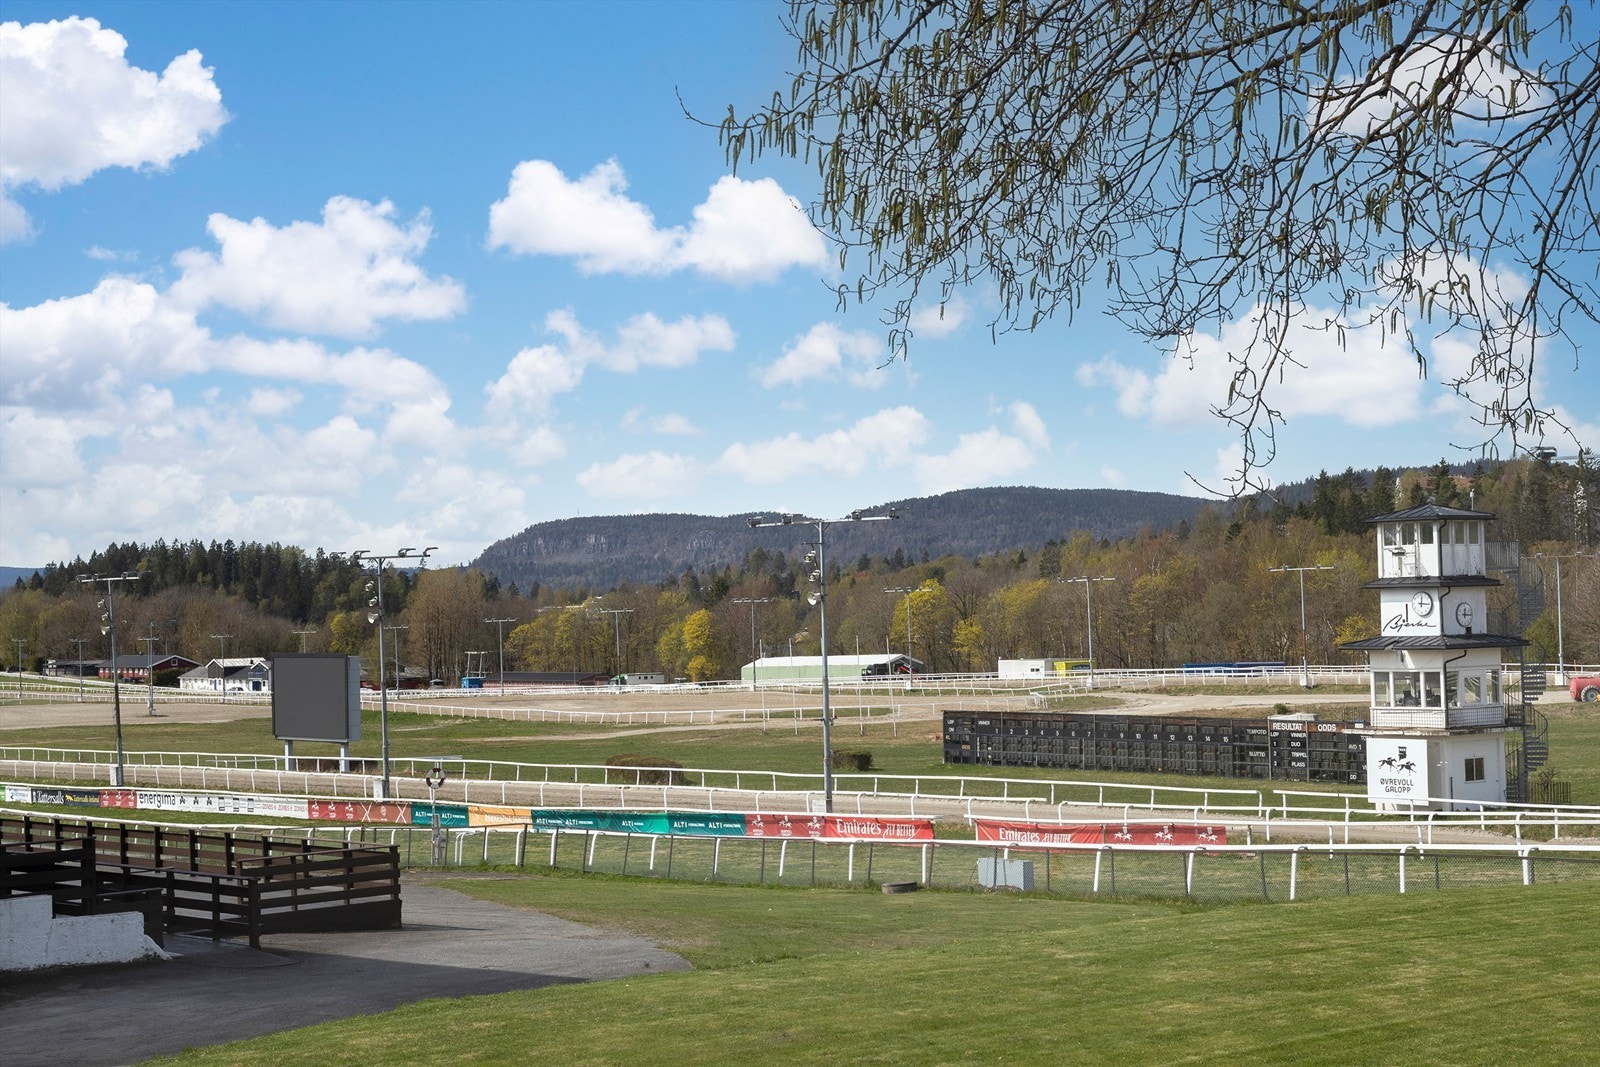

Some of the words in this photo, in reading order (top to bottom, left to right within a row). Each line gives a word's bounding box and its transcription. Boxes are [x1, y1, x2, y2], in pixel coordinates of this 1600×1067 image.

[1380, 778, 1414, 787] ØVREVOLL
[139, 793, 176, 808] energima
[836, 819, 881, 834] Emirates
[999, 828, 1039, 842] Emirates
